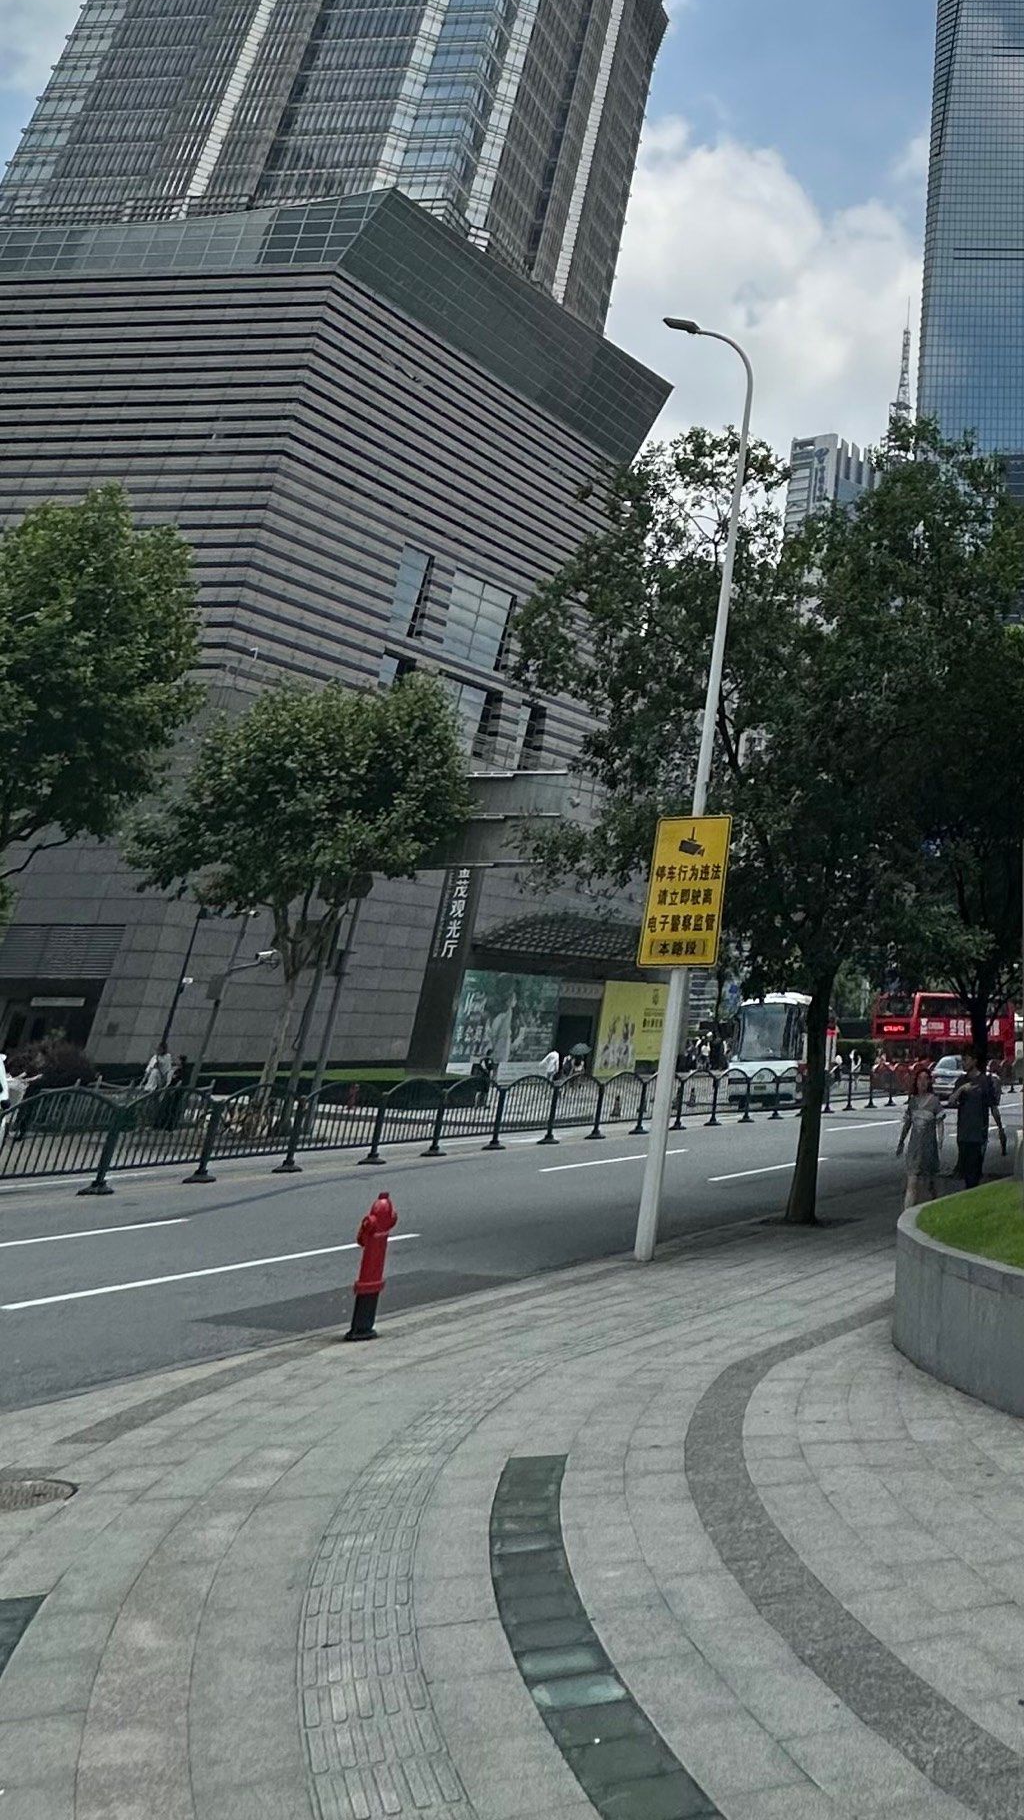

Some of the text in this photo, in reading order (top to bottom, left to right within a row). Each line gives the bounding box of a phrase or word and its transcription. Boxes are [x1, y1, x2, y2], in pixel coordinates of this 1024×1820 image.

[656, 864, 721, 882] 停车行为违法
[658, 888, 713, 906] 请立即驶离
[648, 914, 716, 933] 电子警察监管
